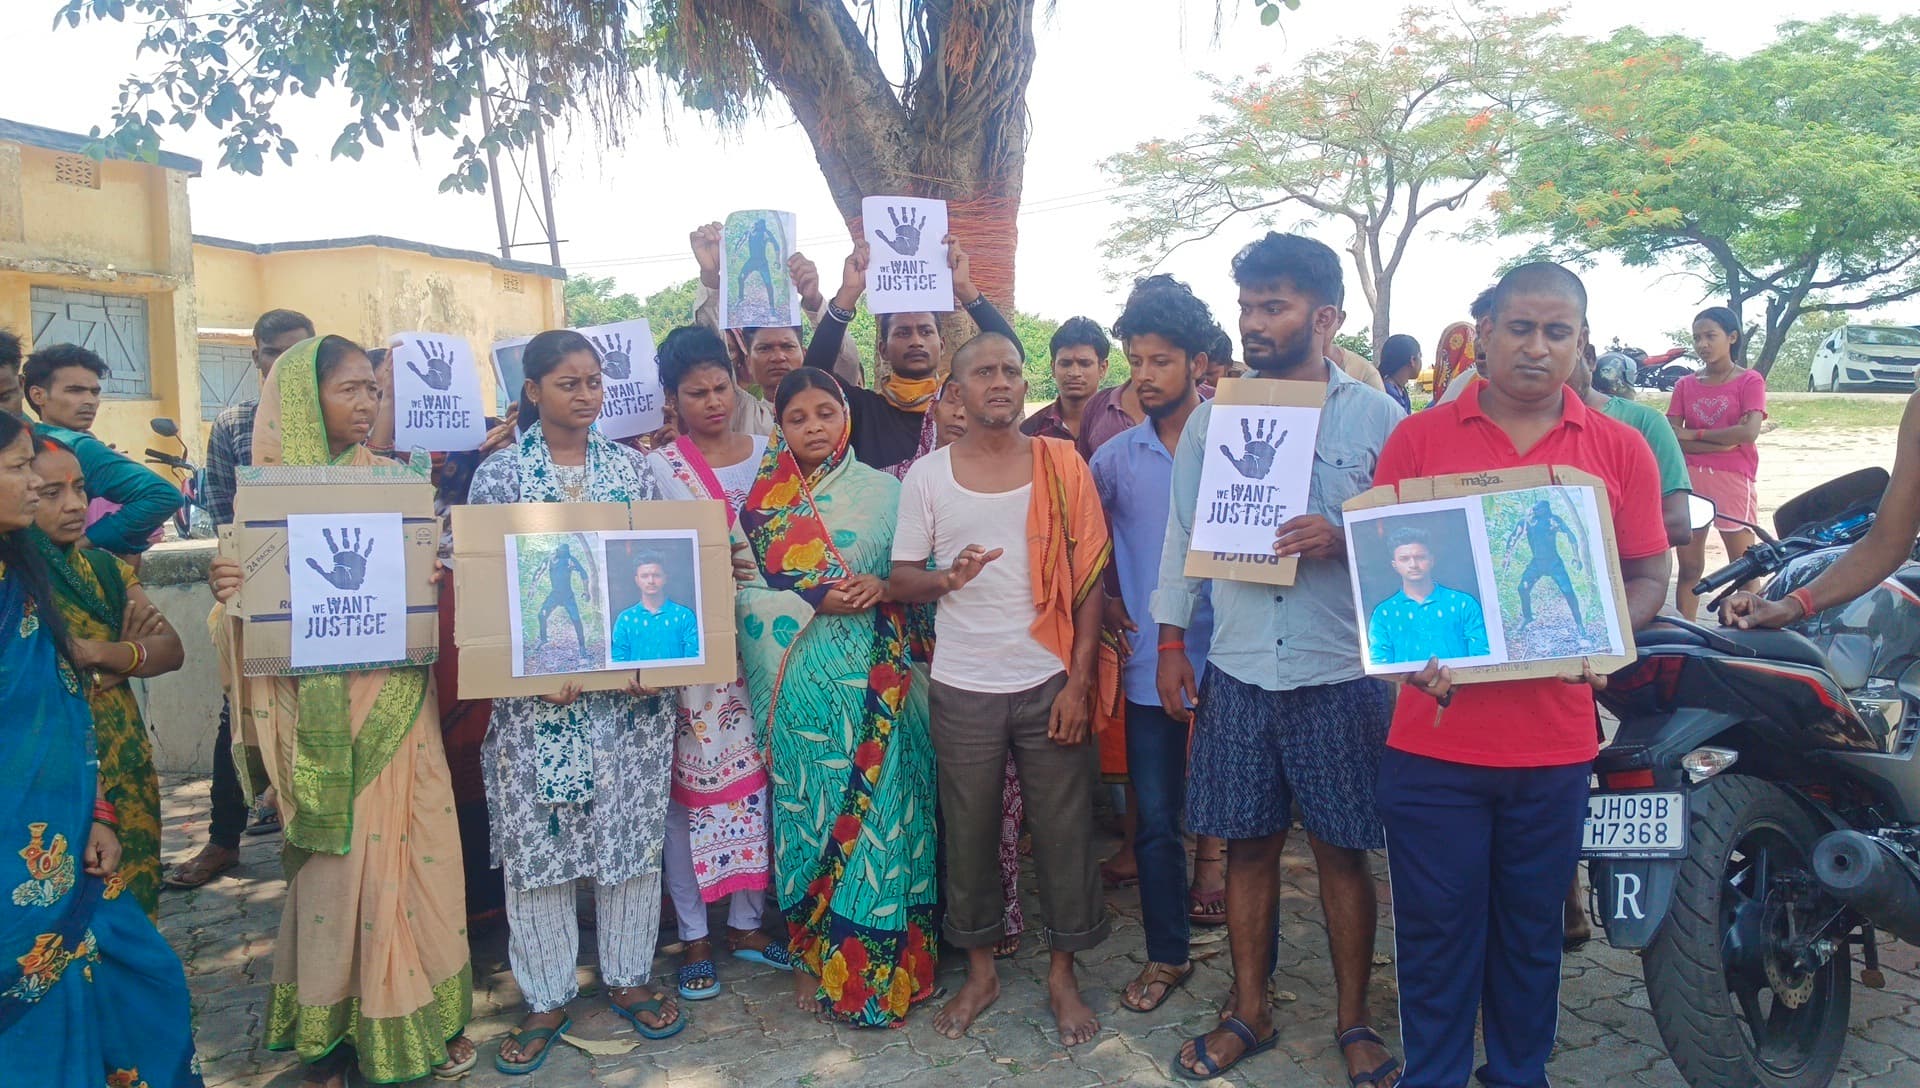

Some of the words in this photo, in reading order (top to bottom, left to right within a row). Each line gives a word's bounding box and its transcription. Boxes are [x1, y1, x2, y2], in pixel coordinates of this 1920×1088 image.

[891, 260, 928, 274] WANT
[875, 274, 937, 292] JUSTICE
[607, 381, 644, 399] WANT
[411, 399, 421, 408] WE
[422, 395, 462, 410] WANT
[405, 410, 470, 429] JUSTICE
[1216, 489, 1229, 500] WE
[1230, 483, 1281, 503] WANT
[1206, 502, 1287, 527] JUSTICE
[312, 604, 325, 614] WE
[326, 595, 378, 614] WANT
[304, 613, 387, 639] JUSTICE
[1593, 797, 1669, 820] JH09B
[1591, 822, 1669, 845] H7368
[1614, 873, 1646, 920] R
